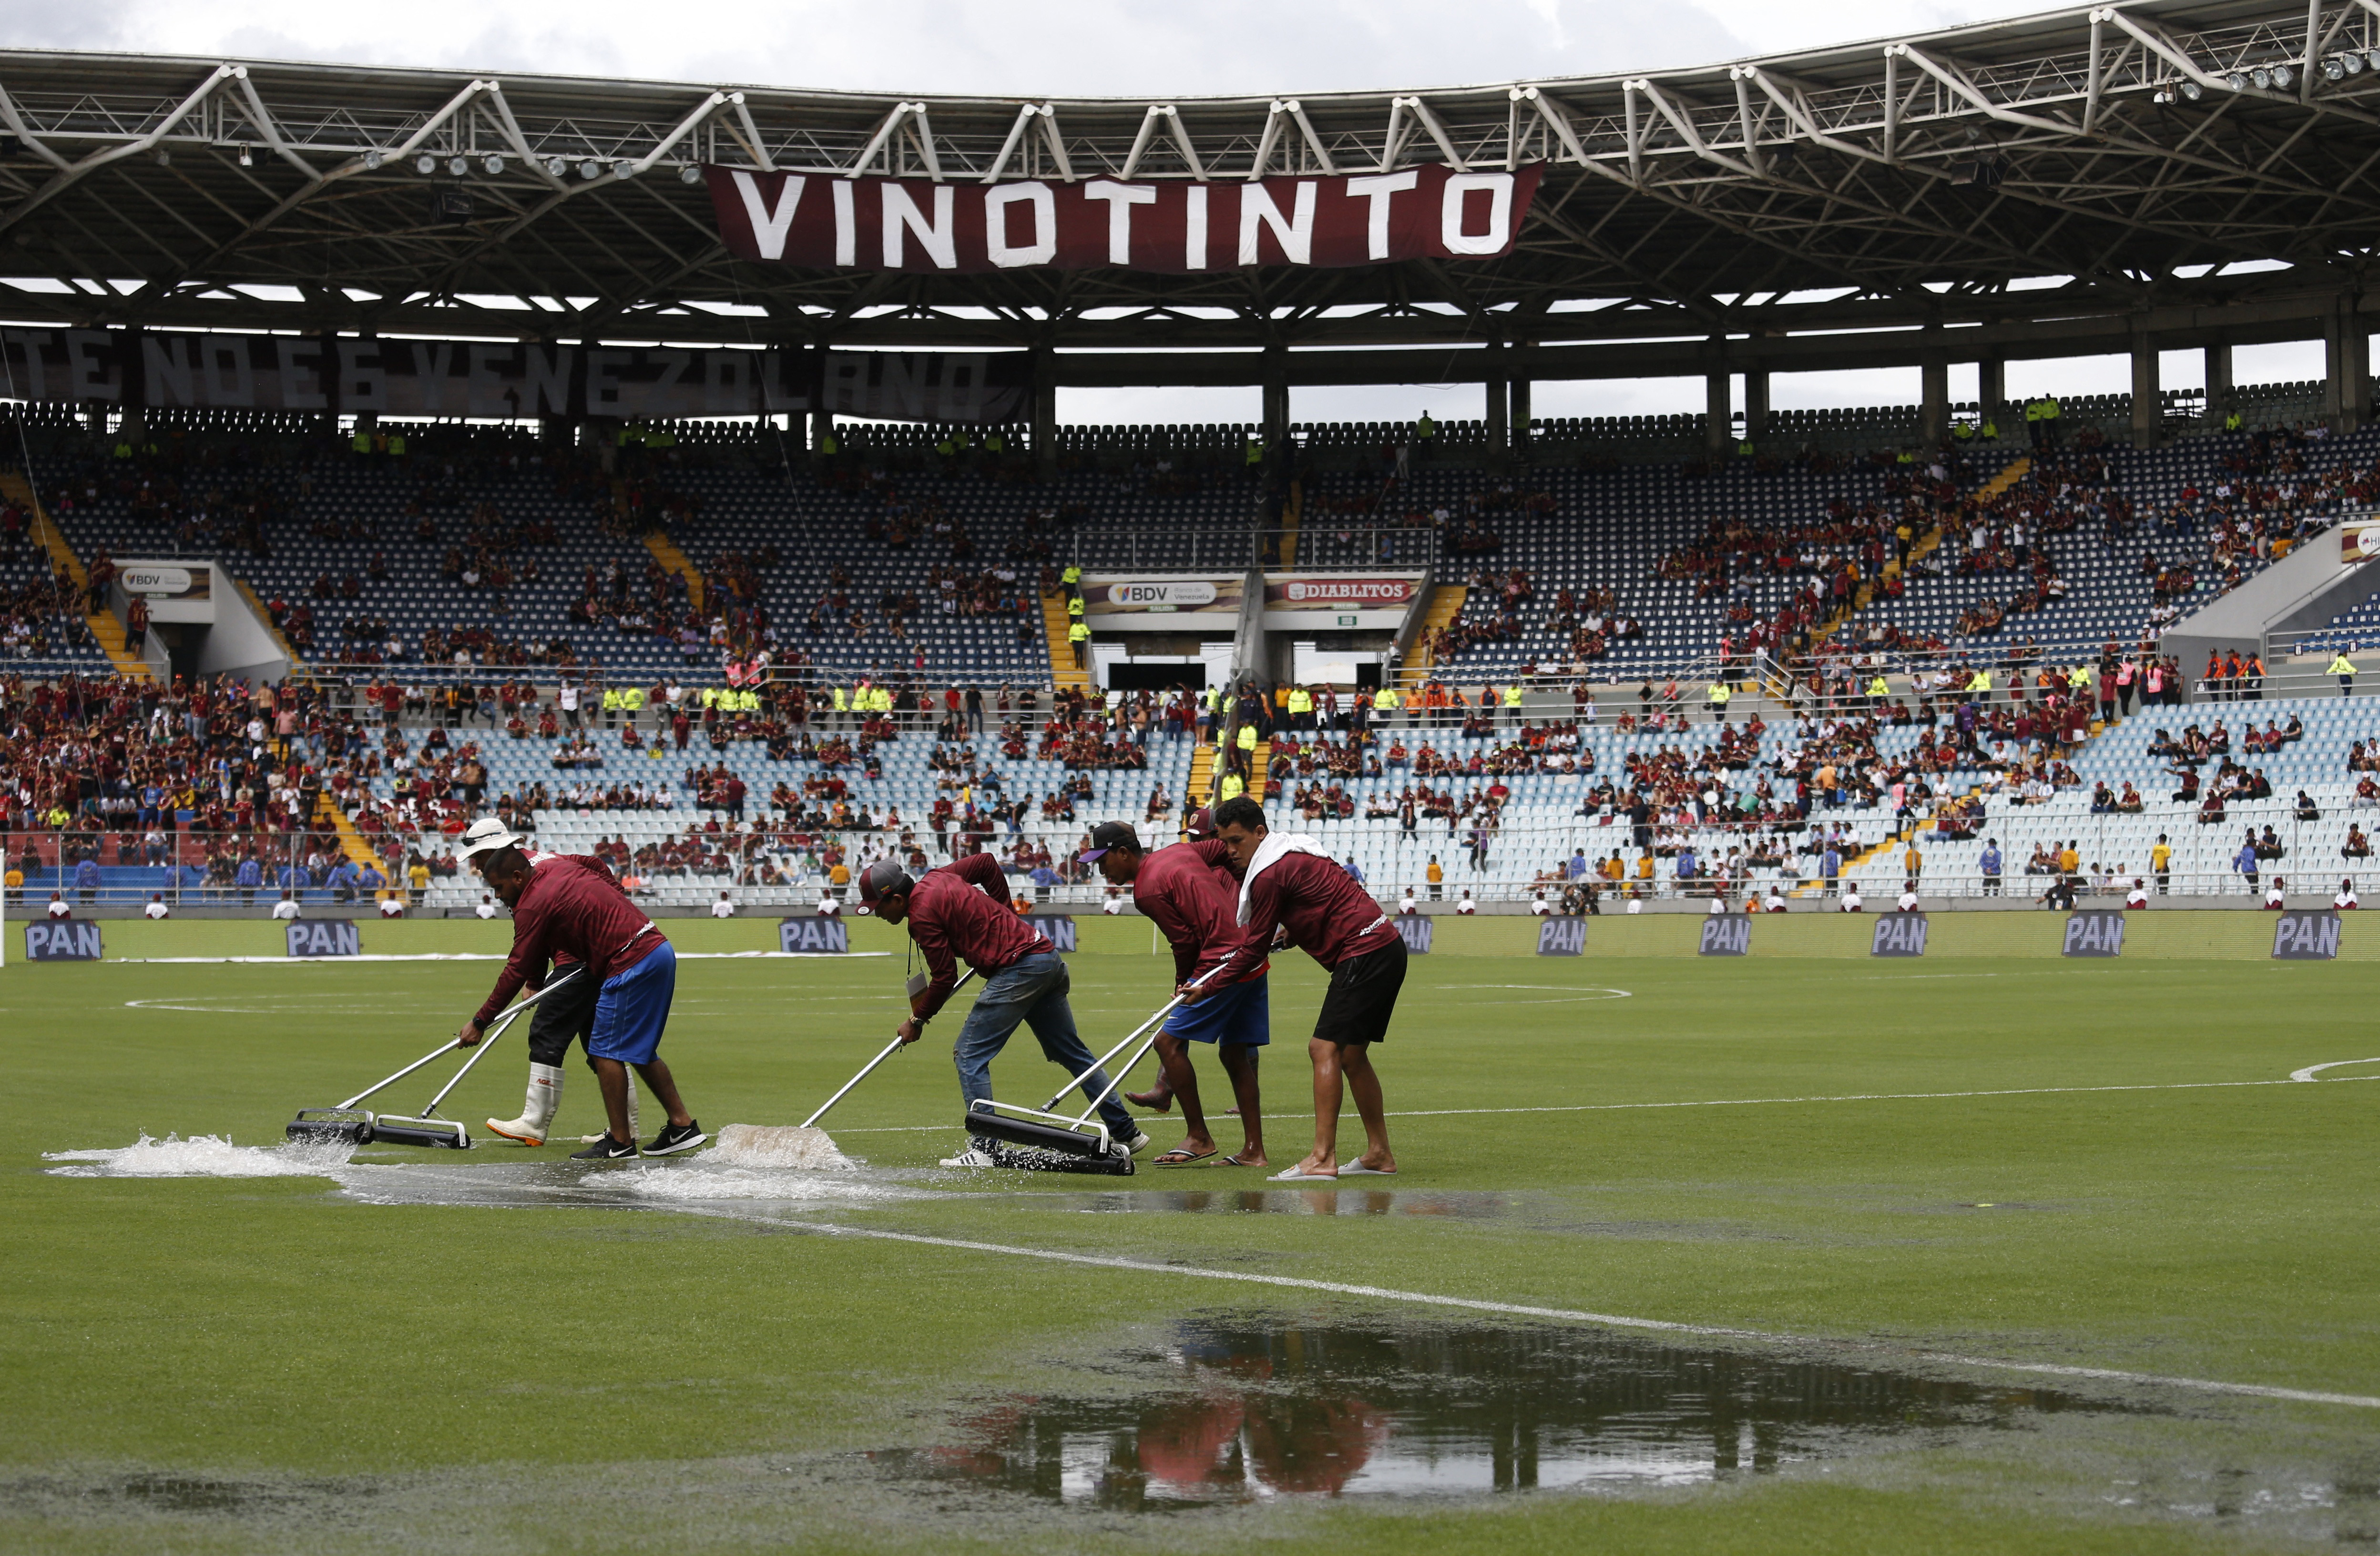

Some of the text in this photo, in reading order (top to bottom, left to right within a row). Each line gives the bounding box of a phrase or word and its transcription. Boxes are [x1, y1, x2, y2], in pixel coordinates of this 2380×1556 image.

[731, 169, 1516, 270] VINOTINTO
[137, 576, 160, 585] BDV
[1132, 587, 1167, 601] BDV
[1306, 584, 1403, 598] DIABLITOS
